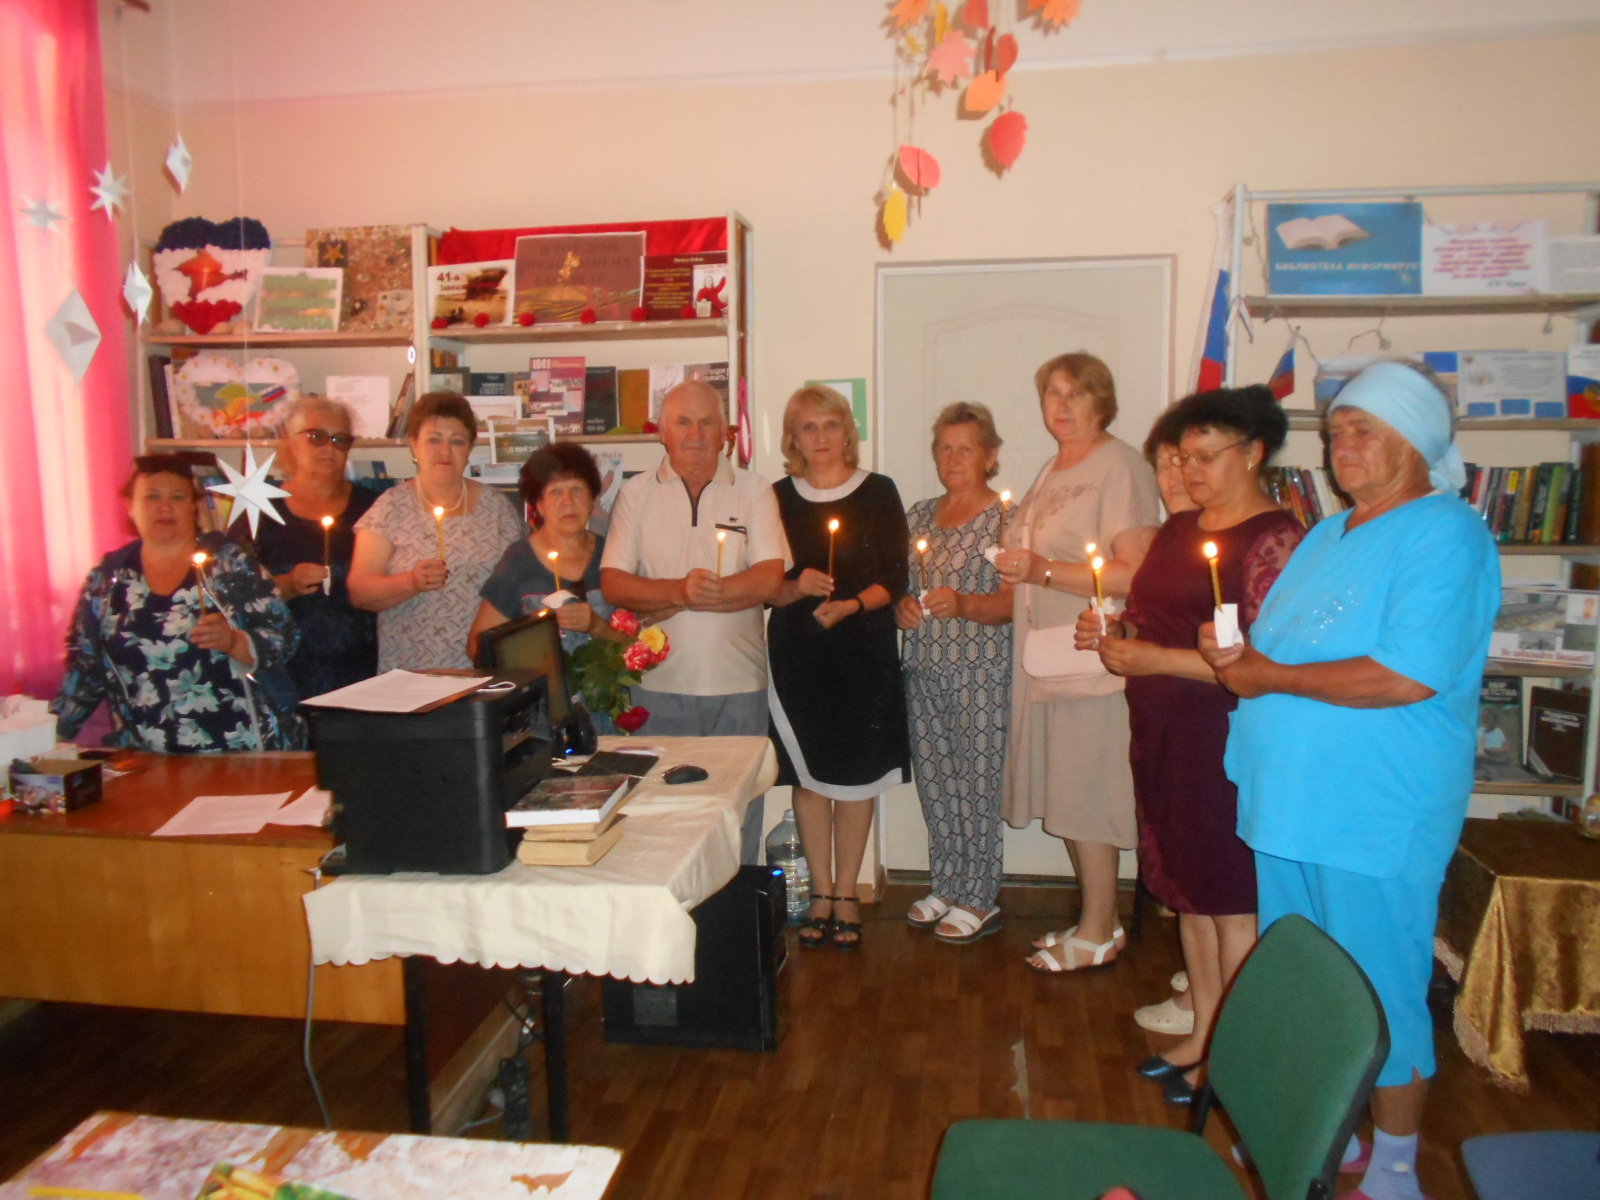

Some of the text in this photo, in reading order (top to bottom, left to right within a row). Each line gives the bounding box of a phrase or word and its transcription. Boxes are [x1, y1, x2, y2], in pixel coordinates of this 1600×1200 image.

[1275, 262, 1421, 271] БИБЛИОТЕКА ИНФОРМИРУЕ
[532, 359, 552, 370] 1941
